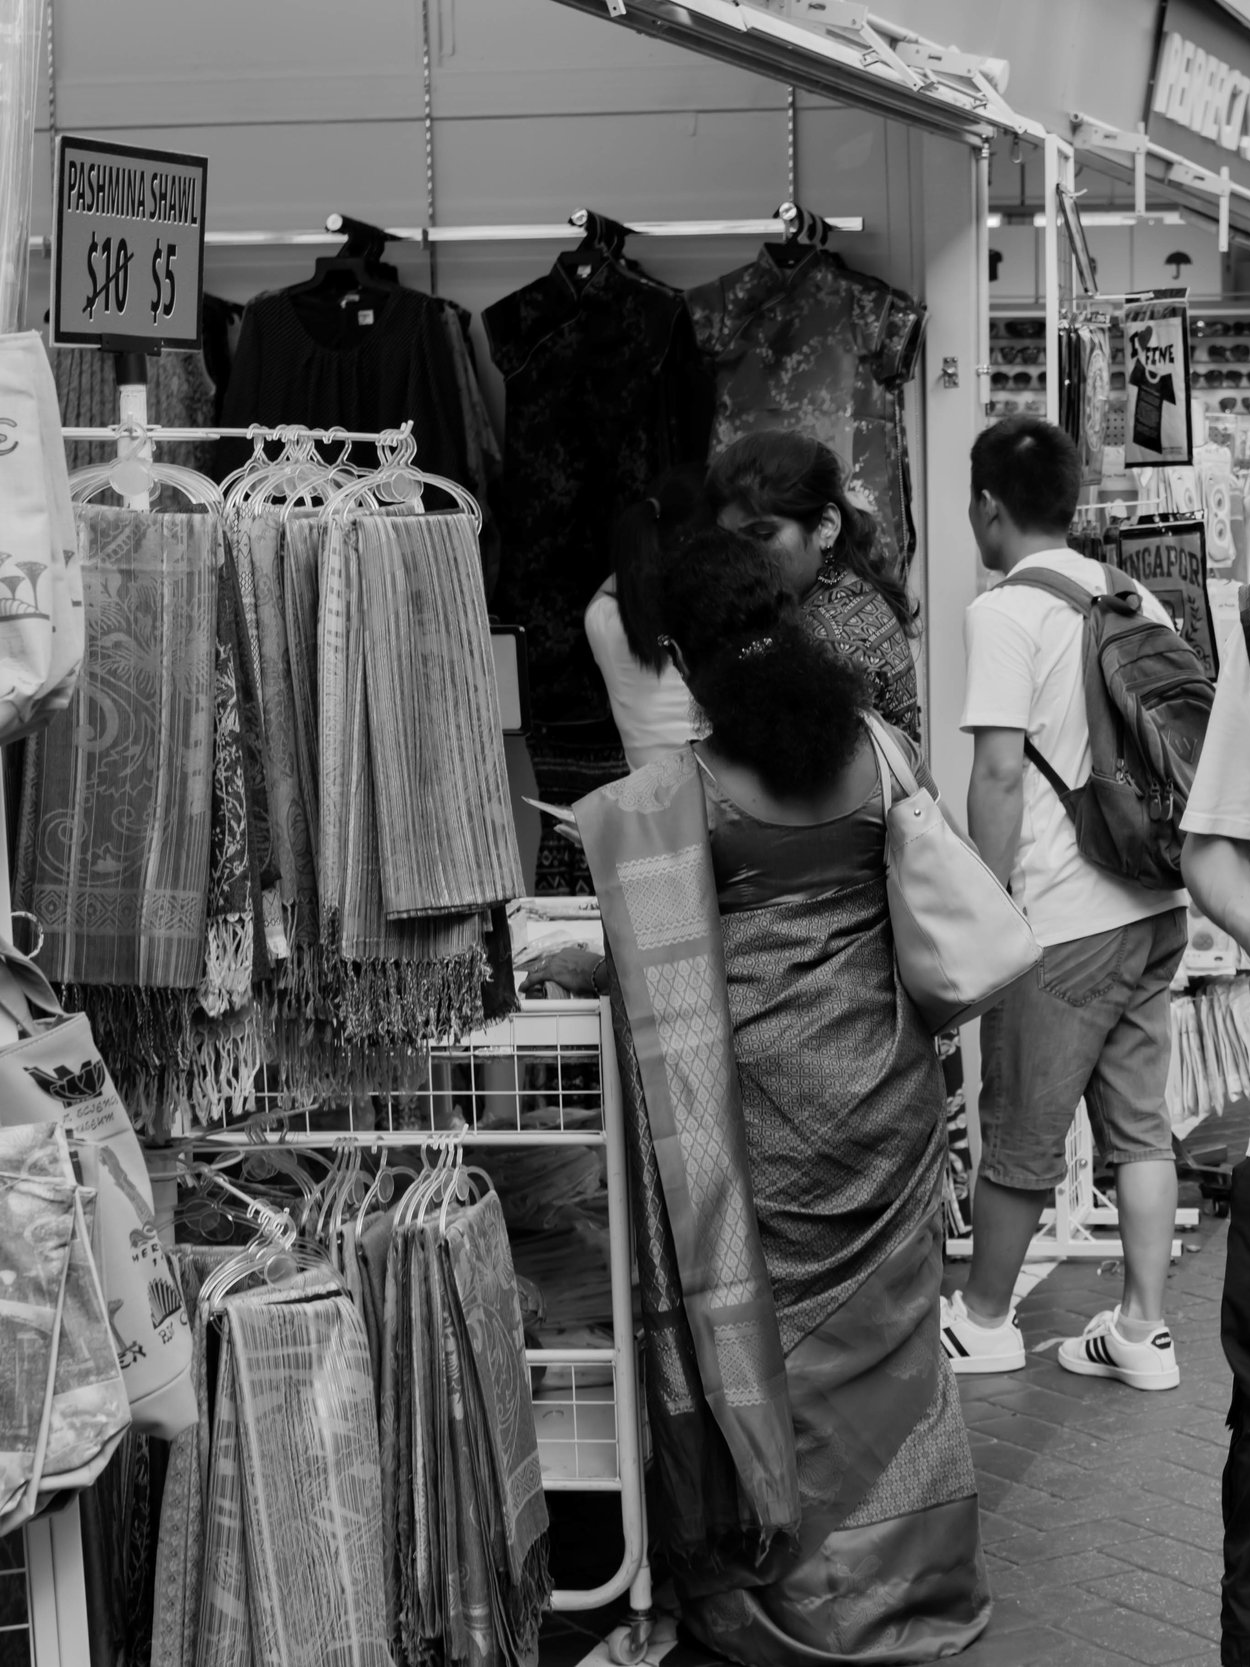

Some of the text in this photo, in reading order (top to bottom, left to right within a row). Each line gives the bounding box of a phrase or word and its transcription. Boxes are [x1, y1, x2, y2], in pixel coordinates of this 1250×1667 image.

[68, 160, 198, 227] PASHMINA SHAWL
[85, 231, 177, 326] $10 $5
[1145, 344, 1175, 366] FINE
